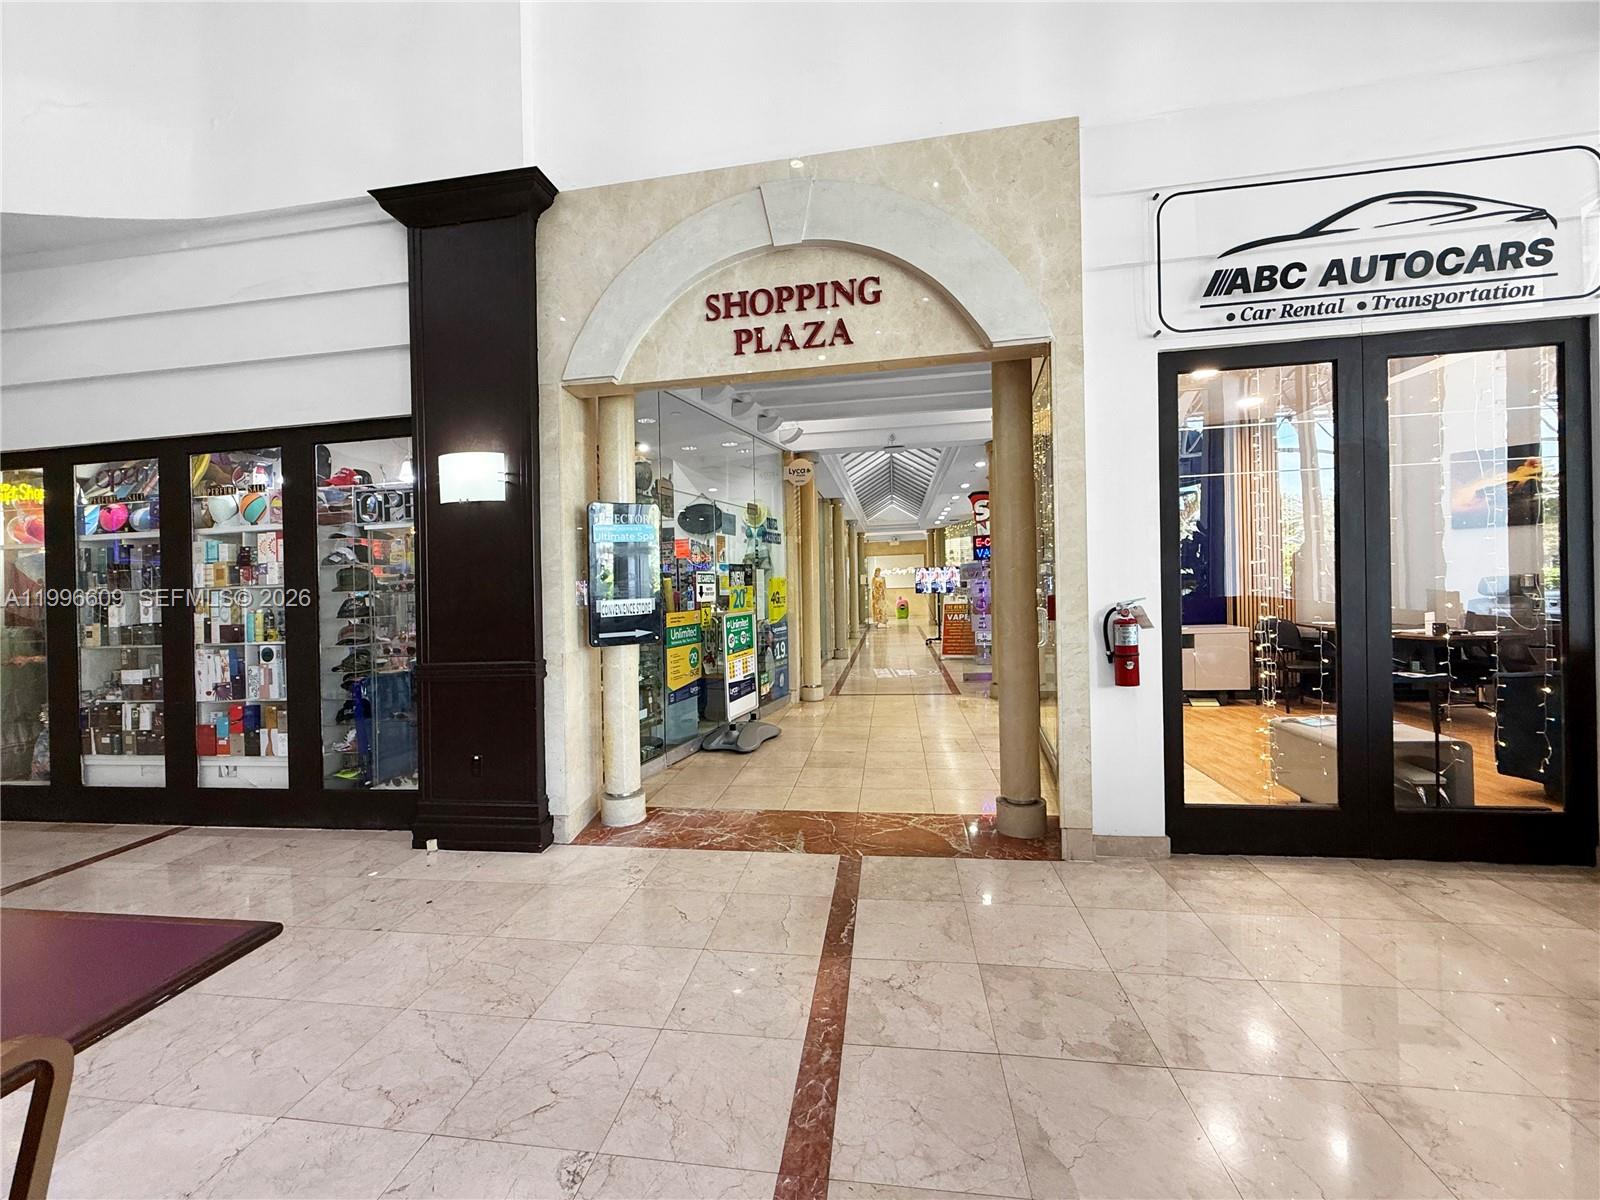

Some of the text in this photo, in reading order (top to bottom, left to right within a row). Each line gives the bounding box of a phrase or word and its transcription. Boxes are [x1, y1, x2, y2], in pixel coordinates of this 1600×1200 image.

[1224, 238, 1555, 295] ABC AUTOCARS
[705, 276, 882, 321] SHOPPING
[1240, 281, 1535, 322] Car Rental Transportation
[733, 318, 854, 355] PLAZA
[788, 467, 806, 475] Lyca
[594, 531, 655, 543] Ultimate Spa
[602, 601, 652, 616] CONVENIENCE STORE
[731, 616, 749, 629] Unlimited
[670, 625, 698, 640] Unlimited
